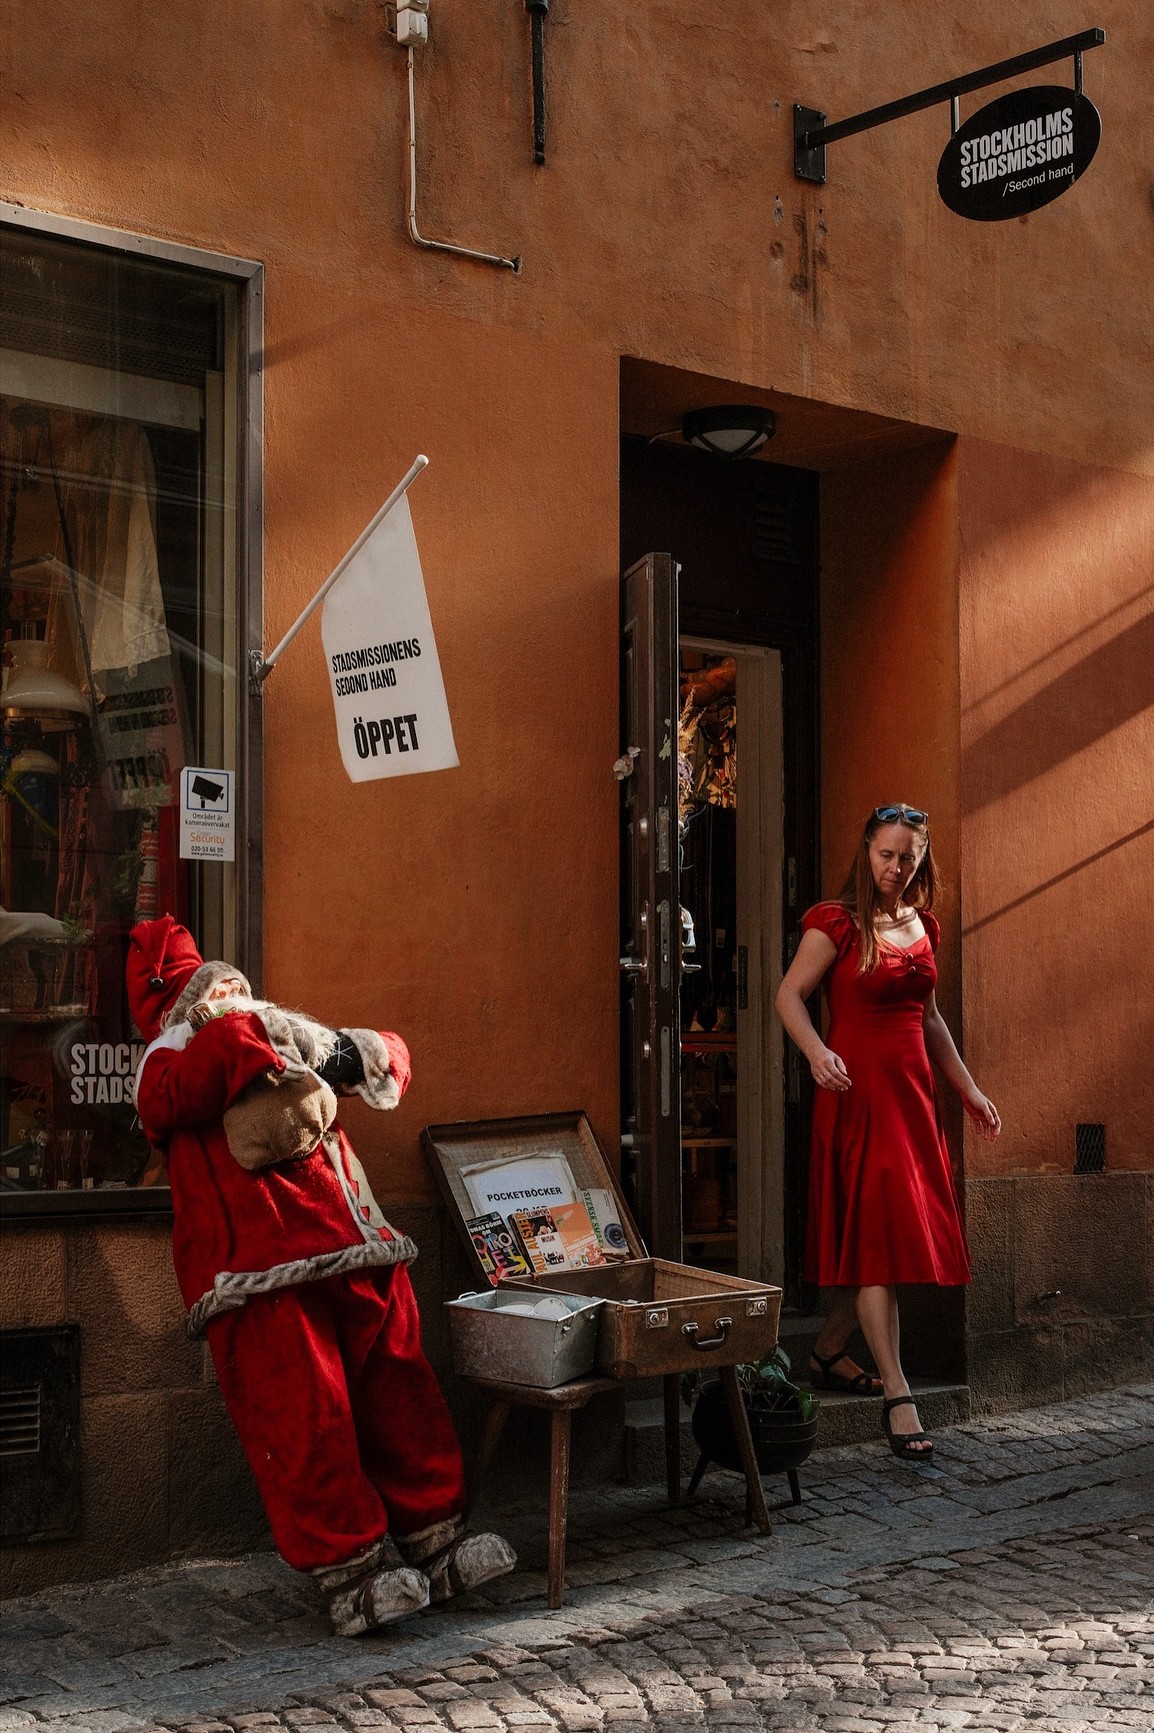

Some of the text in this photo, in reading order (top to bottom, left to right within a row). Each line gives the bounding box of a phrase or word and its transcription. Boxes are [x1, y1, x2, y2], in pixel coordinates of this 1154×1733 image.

[960, 107, 1074, 166] STOCKHOLMS
[960, 132, 1074, 188] STADSMISSION
[1049, 163, 1074, 181] hand
[331, 638, 422, 674] STADSMISSIONENS
[369, 668, 397, 690] HAND
[353, 713, 419, 759] ÖPPET
[190, 832, 225, 846] Security
[487, 1187, 563, 1202] POCKETBÖCKER
